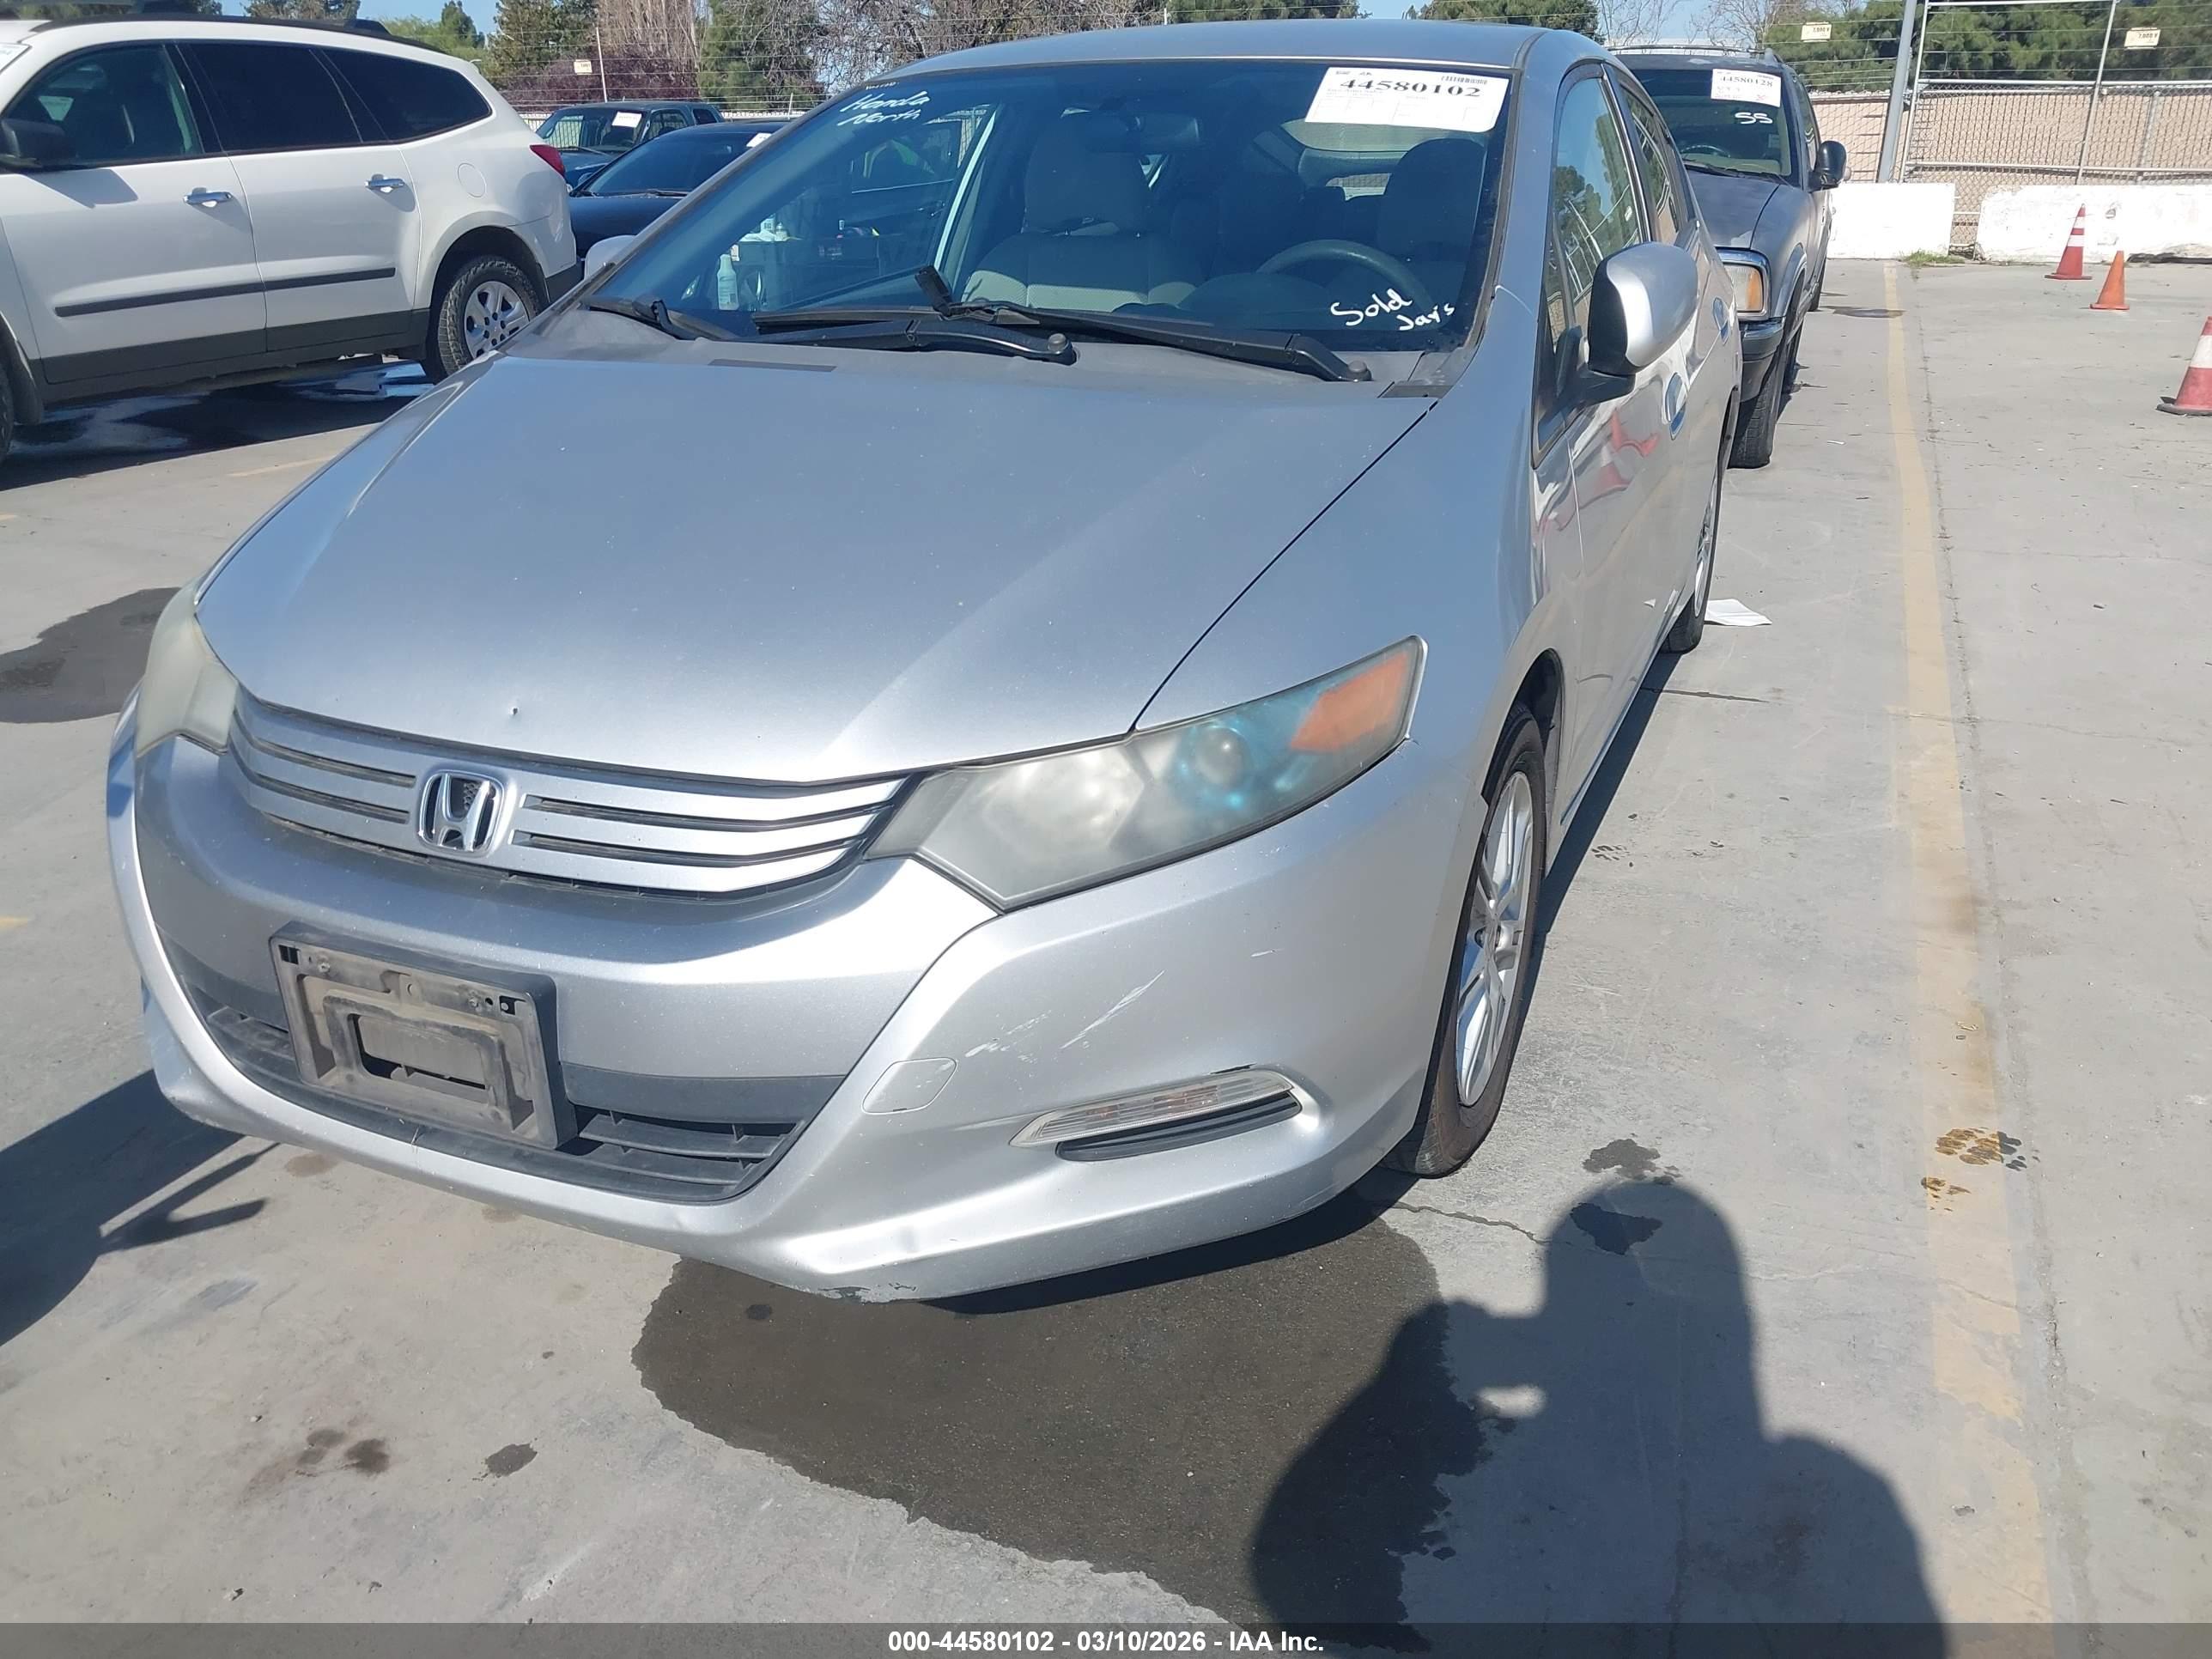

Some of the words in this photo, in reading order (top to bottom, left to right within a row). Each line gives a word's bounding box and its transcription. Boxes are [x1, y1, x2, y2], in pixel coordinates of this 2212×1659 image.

[1340, 78, 1481, 97] 44580102
[1720, 75, 1773, 88] 44580128
[1330, 288, 1413, 326] Sold
